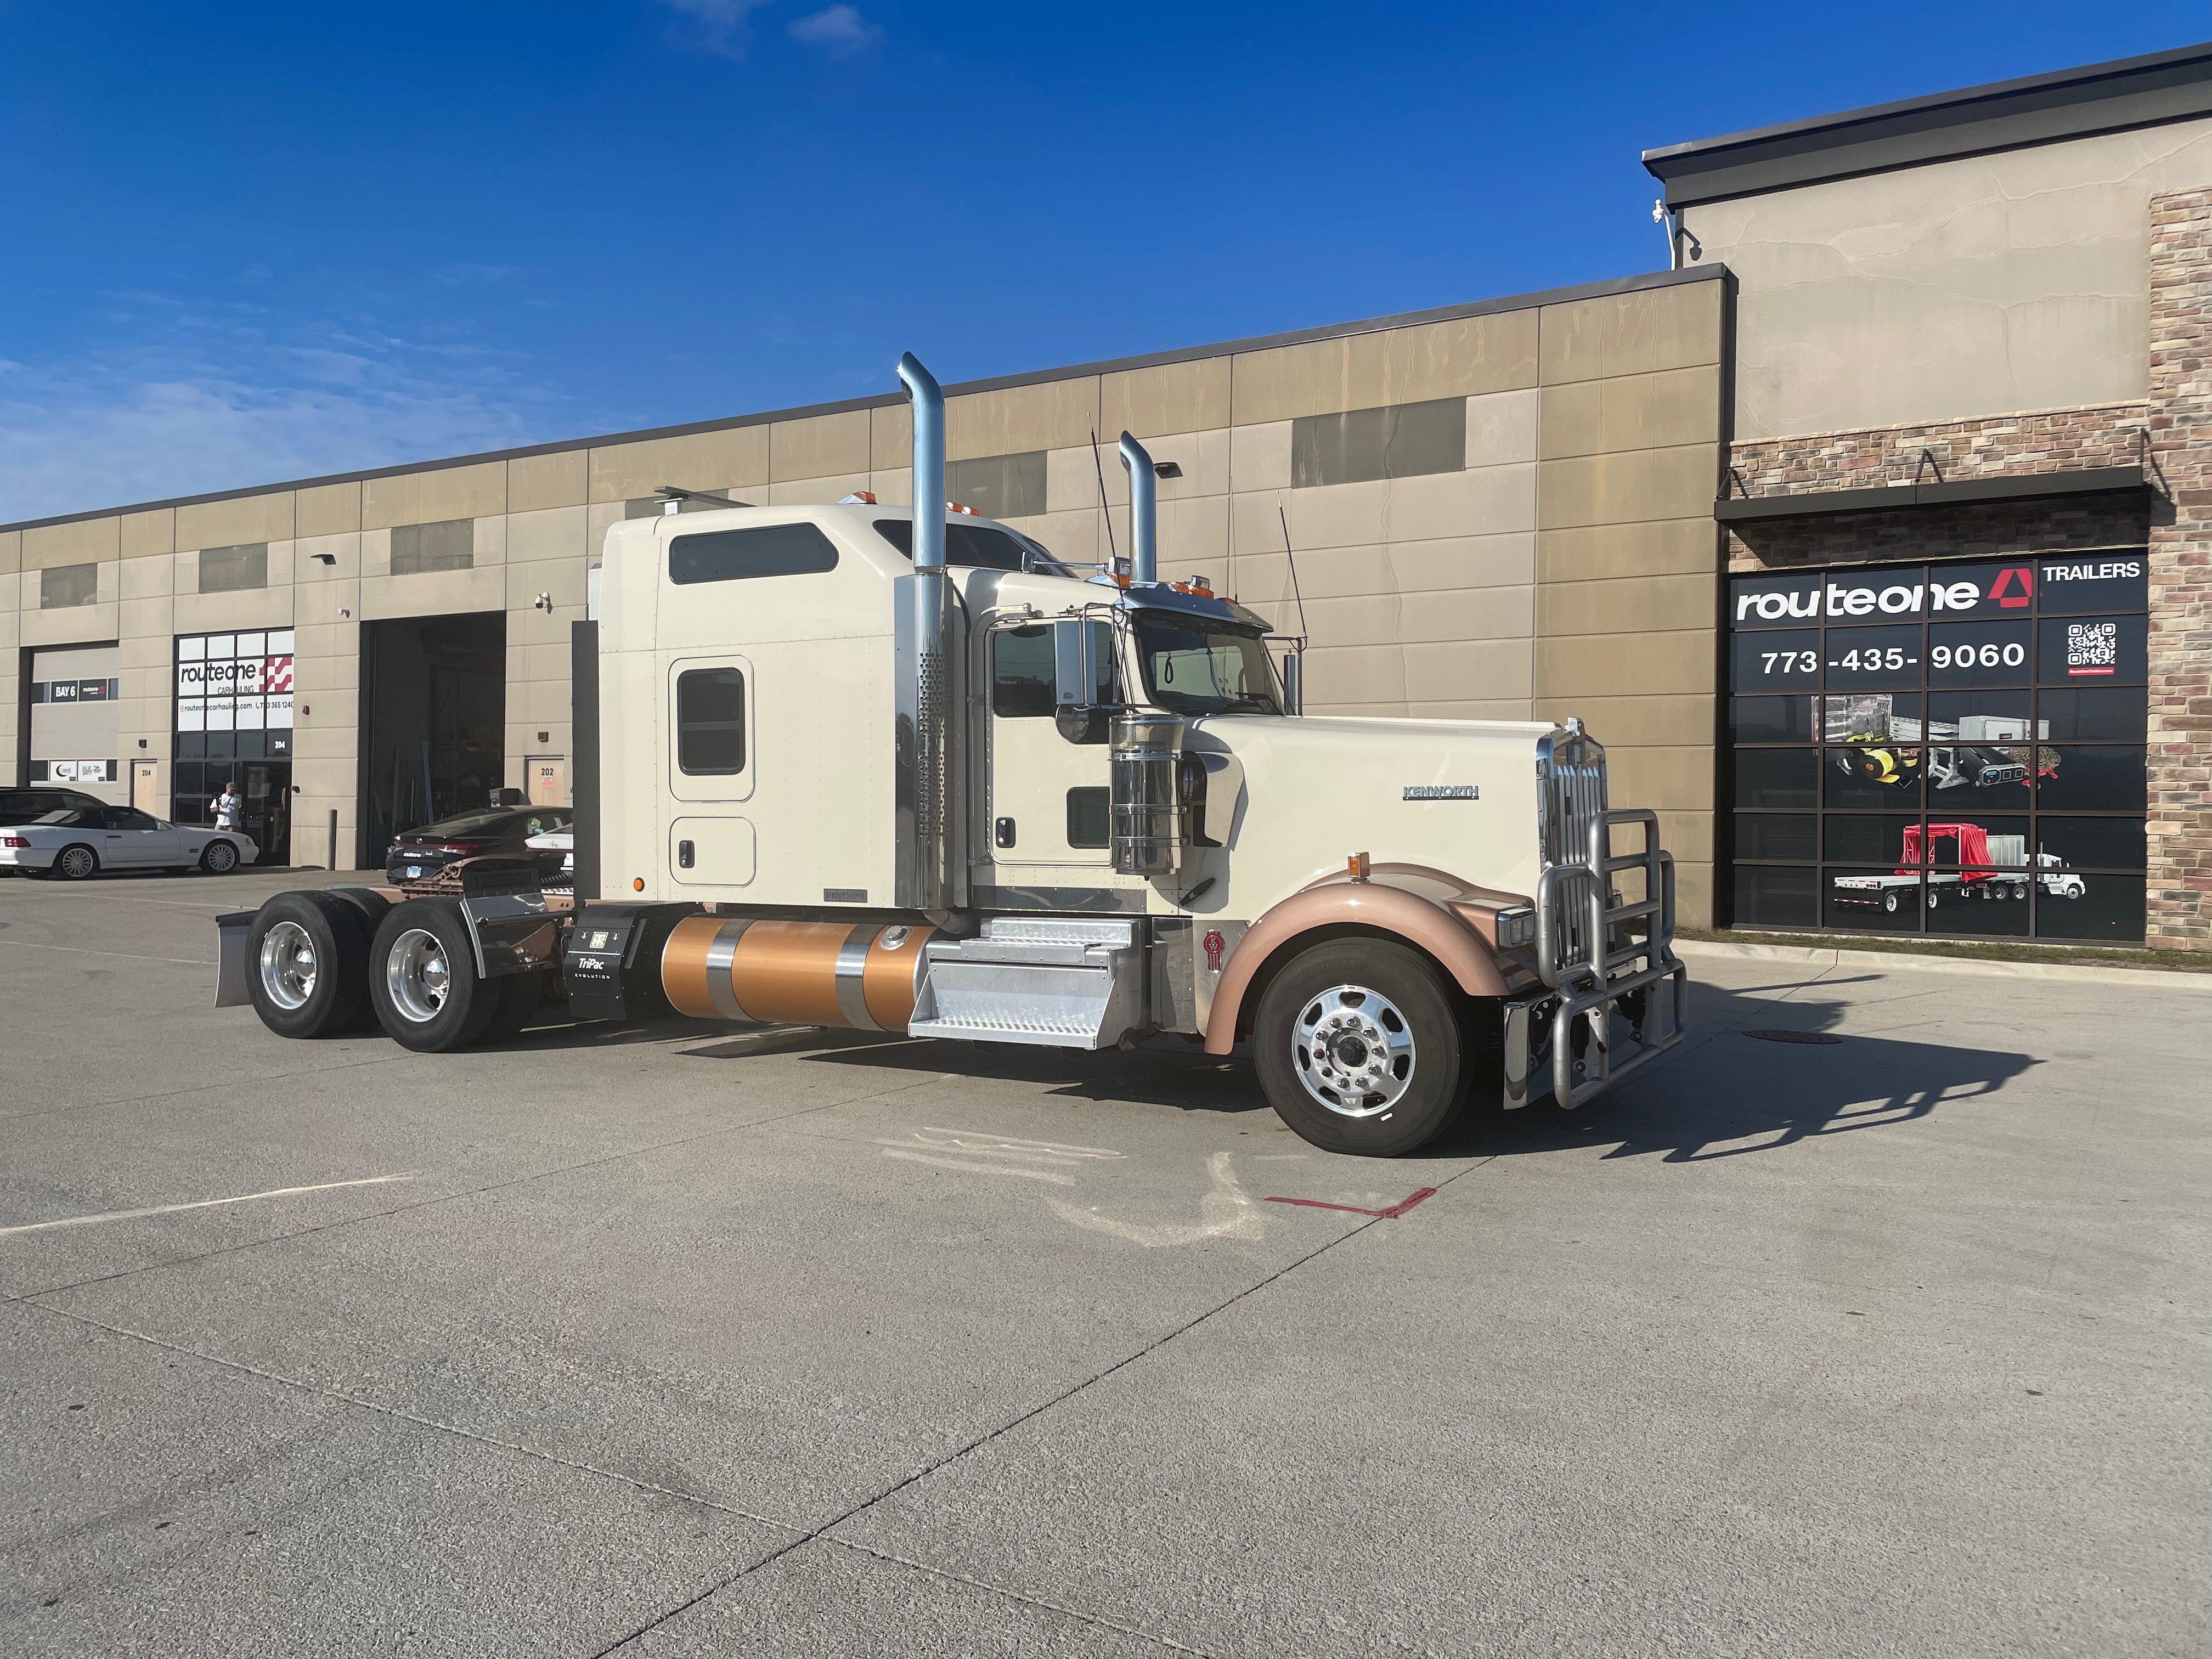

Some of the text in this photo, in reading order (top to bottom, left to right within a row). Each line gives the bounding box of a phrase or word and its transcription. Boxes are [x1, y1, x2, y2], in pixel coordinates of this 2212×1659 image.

[2042, 561, 2141, 582] TRAILERS
[1737, 580, 1980, 621] routeone
[1760, 650, 1818, 674] 773
[1931, 642, 2025, 669] 9060
[181, 663, 256, 683] routeone
[55, 685, 76, 697] BAY 6
[217, 685, 254, 695] CARHULING
[275, 741, 285, 749] 204
[541, 768, 554, 776] 202
[1403, 786, 1479, 798] KENWORTH
[579, 958, 605, 970] TriPac
